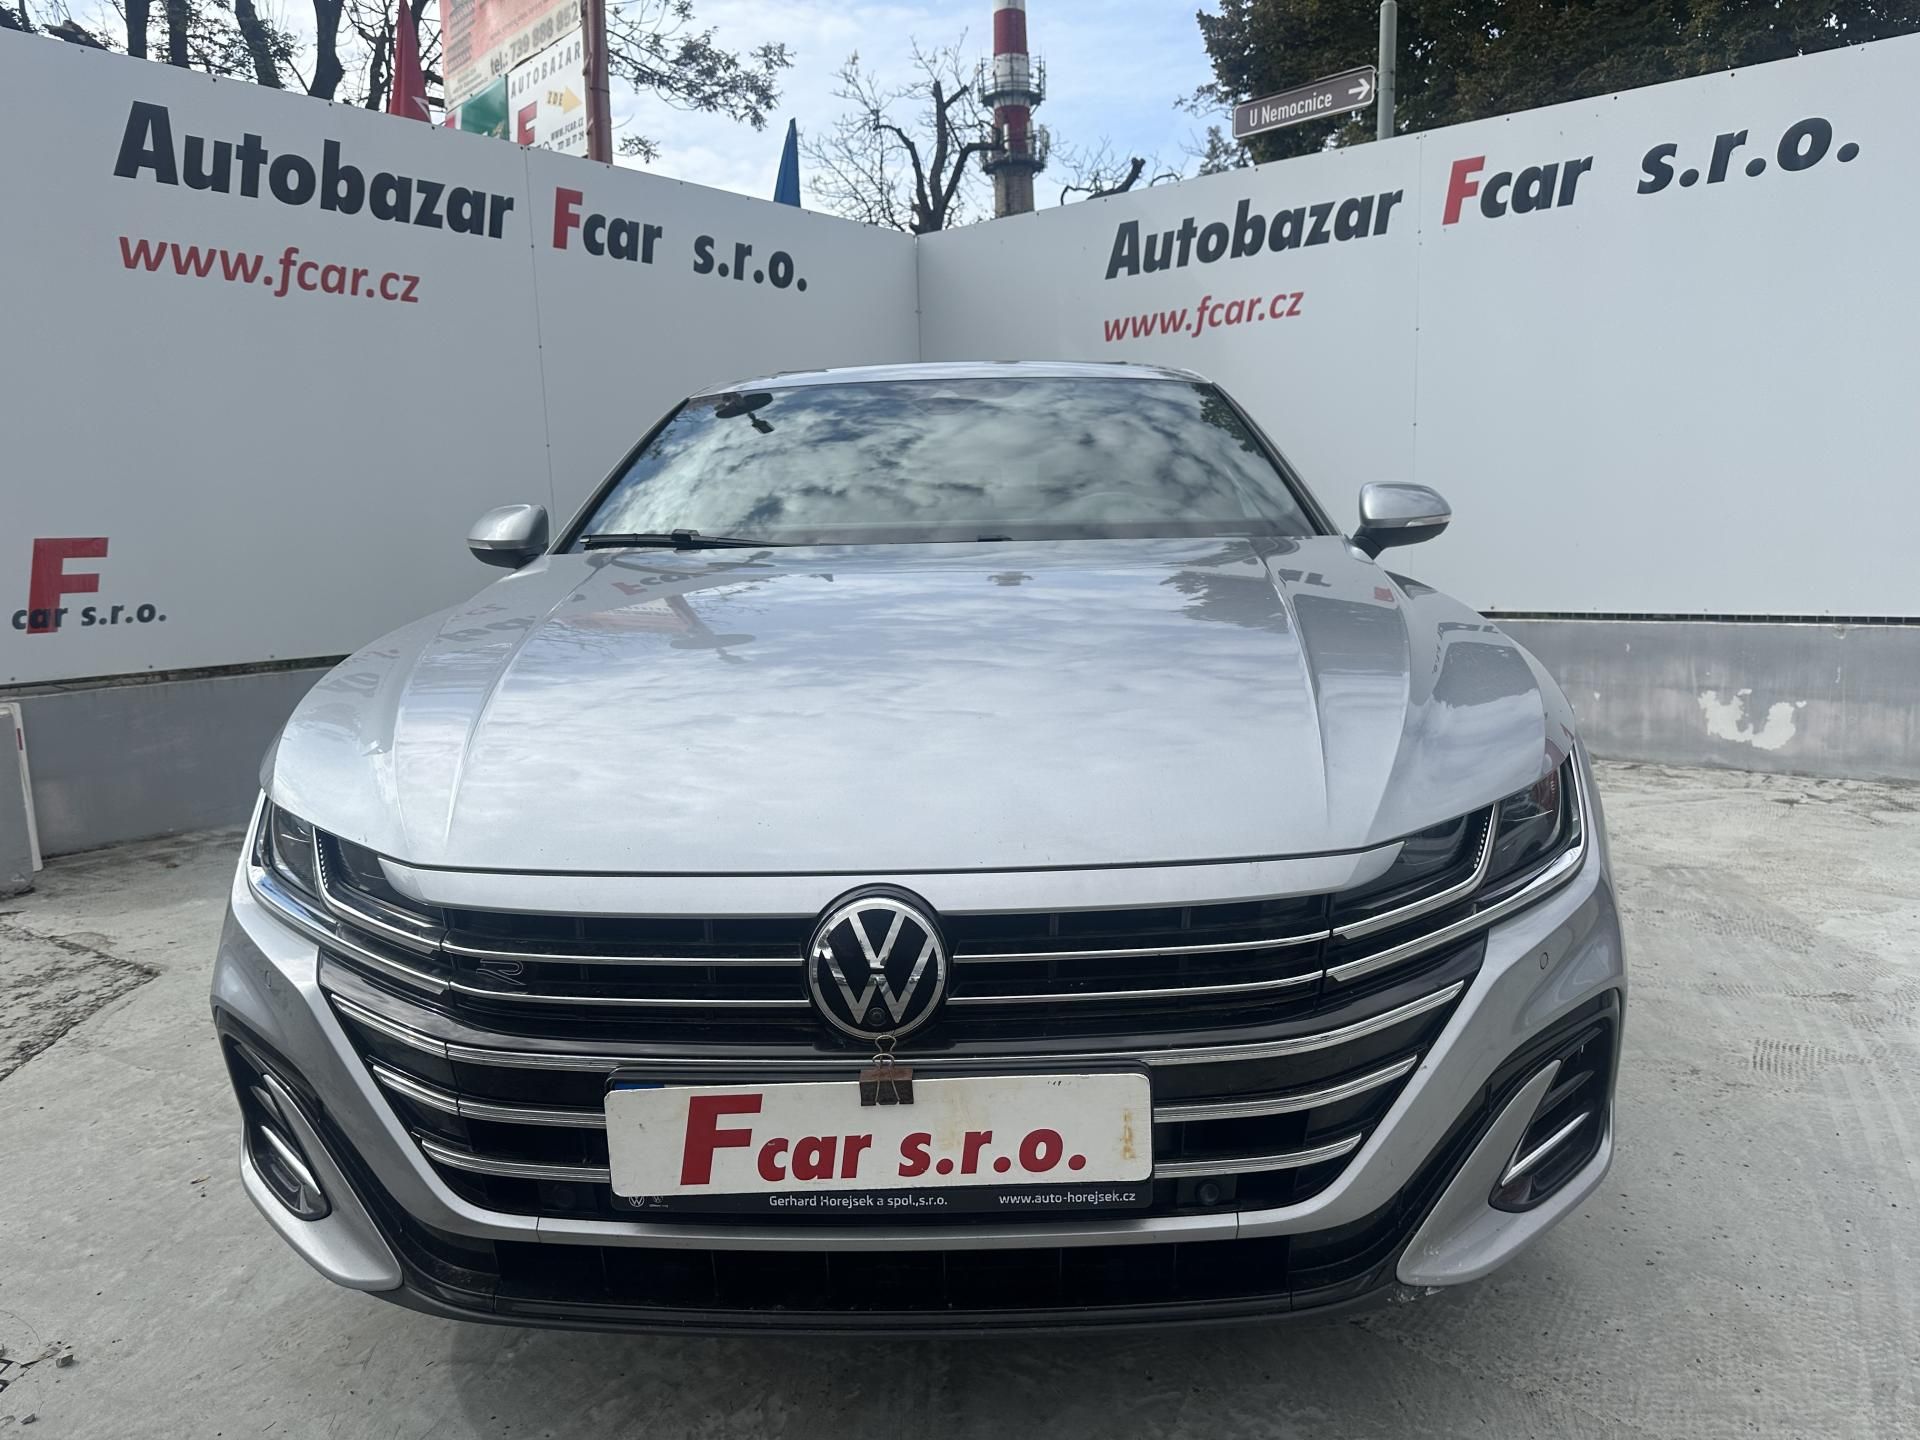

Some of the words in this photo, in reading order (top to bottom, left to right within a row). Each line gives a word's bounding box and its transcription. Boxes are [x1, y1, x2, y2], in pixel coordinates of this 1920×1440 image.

[511, 40, 581, 99] AUTOBAZAR
[1249, 109, 1258, 126] U
[1261, 92, 1332, 124] Nemocnice
[113, 100, 515, 239] Autobazar
[552, 188, 663, 265] Fcar
[693, 234, 809, 293] s.r.o.
[1105, 189, 1404, 280] Autobazar
[1442, 155, 1594, 225] Fcar
[1637, 117, 1861, 195] s.r.o.
[119, 236, 421, 304] www.fcar.cz
[1104, 291, 1304, 342] www.fcar.cz
[81, 603, 167, 627] s.r.o.
[681, 1094, 873, 1186] Fcar
[898, 1129, 1088, 1178] s.r.o.
[769, 1195, 817, 1207] Gerhard
[820, 1195, 874, 1209] Horejsek
[877, 1198, 884, 1206] a
[999, 1190, 1136, 1205] www.auto-horejsek.cz
